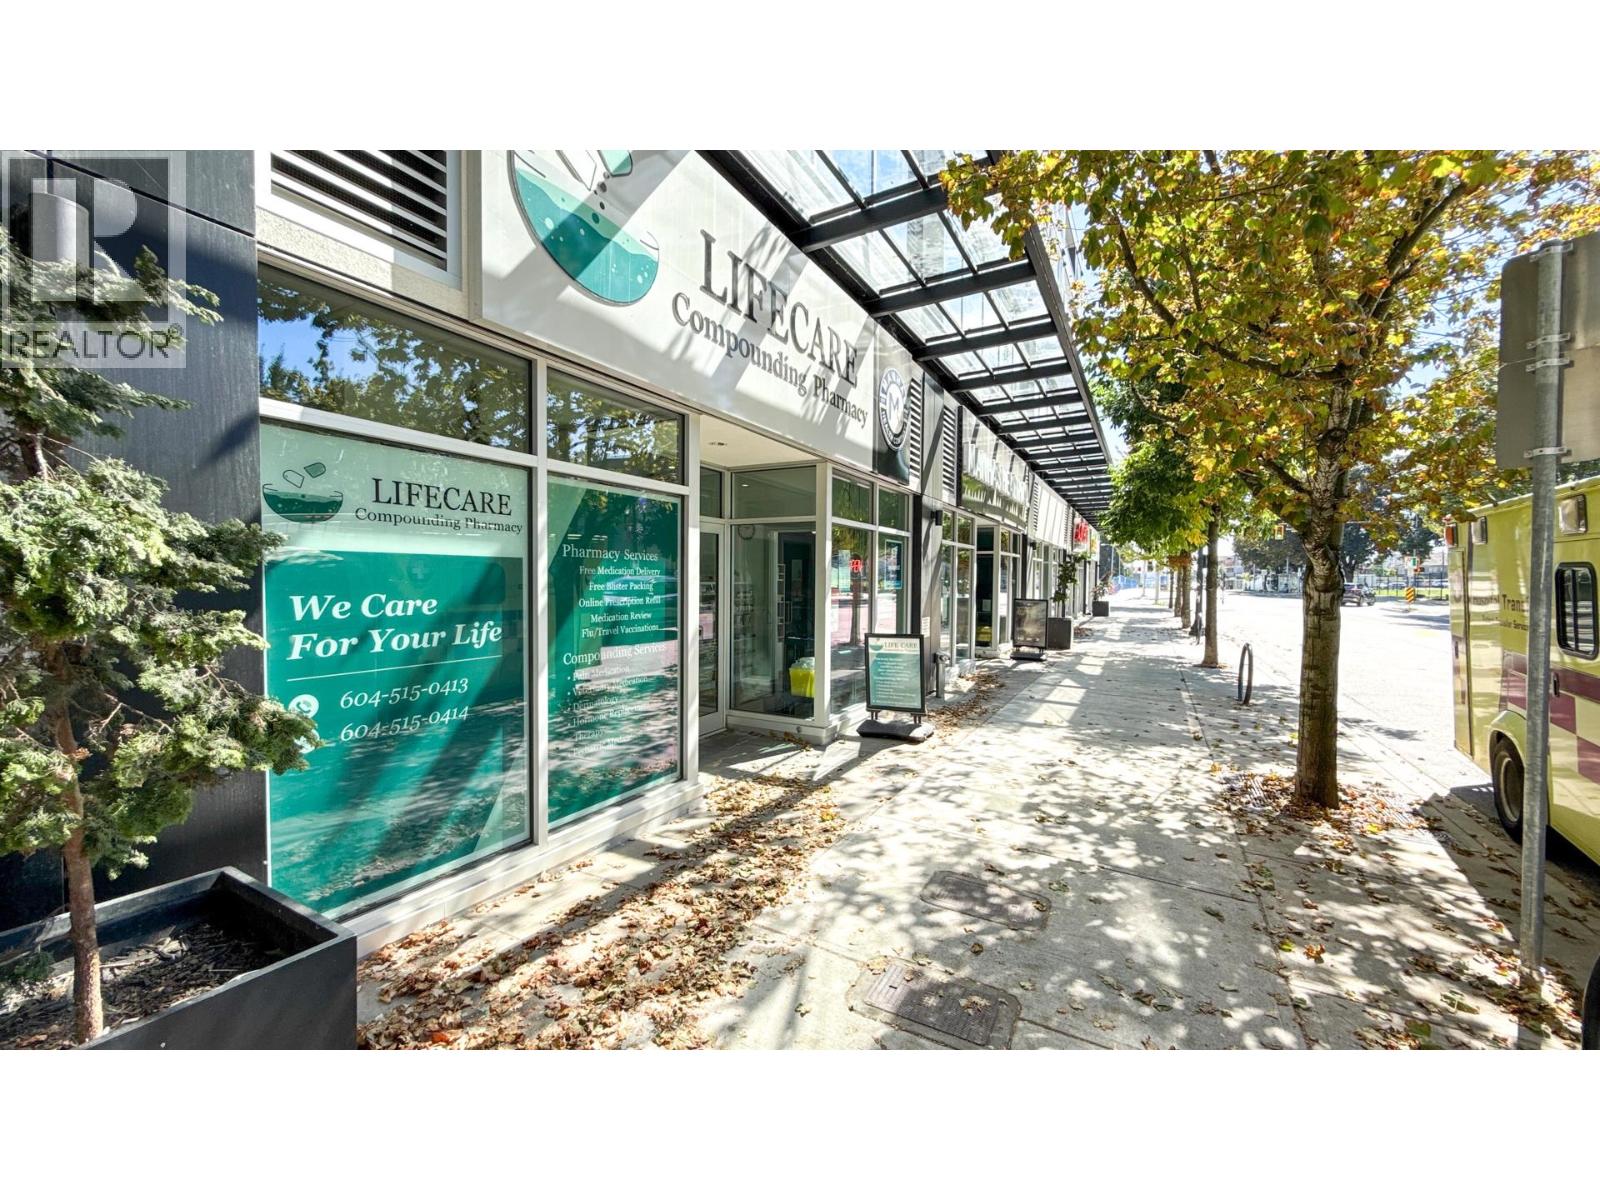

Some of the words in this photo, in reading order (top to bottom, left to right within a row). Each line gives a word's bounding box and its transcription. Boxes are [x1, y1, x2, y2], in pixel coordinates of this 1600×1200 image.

[700, 229, 858, 389] LIFECARE
[672, 292, 808, 397] Compounding
[812, 374, 869, 429] Pharmacy
[371, 477, 513, 516] LIFECARE
[355, 507, 461, 531] Compounding
[465, 518, 523, 535] Pharmacy
[562, 544, 620, 562] Pharmacy
[624, 549, 659, 561] Services
[579, 566, 596, 575] Free
[597, 566, 635, 575] Medication
[636, 567, 660, 577] Delivery
[589, 581, 605, 591] Free
[606, 581, 628, 590] Blister
[629, 581, 654, 592] Packing
[289, 594, 352, 622] We
[361, 593, 438, 619] Care
[579, 598, 604, 608] Online
[605, 597, 644, 607] Prescription
[590, 612, 629, 623] Medication
[630, 611, 652, 620] Review
[286, 633, 359, 660] For
[367, 628, 446, 653] Your
[452, 620, 503, 648] Life
[582, 626, 620, 638] Flu/Travel
[620, 624, 659, 635] Vaccinations
[563, 646, 633, 665] Compounding
[634, 643, 666, 656] Services
[884, 641, 899, 649] LIFE
[339, 677, 469, 709] 604-515-0413
[339, 705, 470, 742] 604-515-0414
